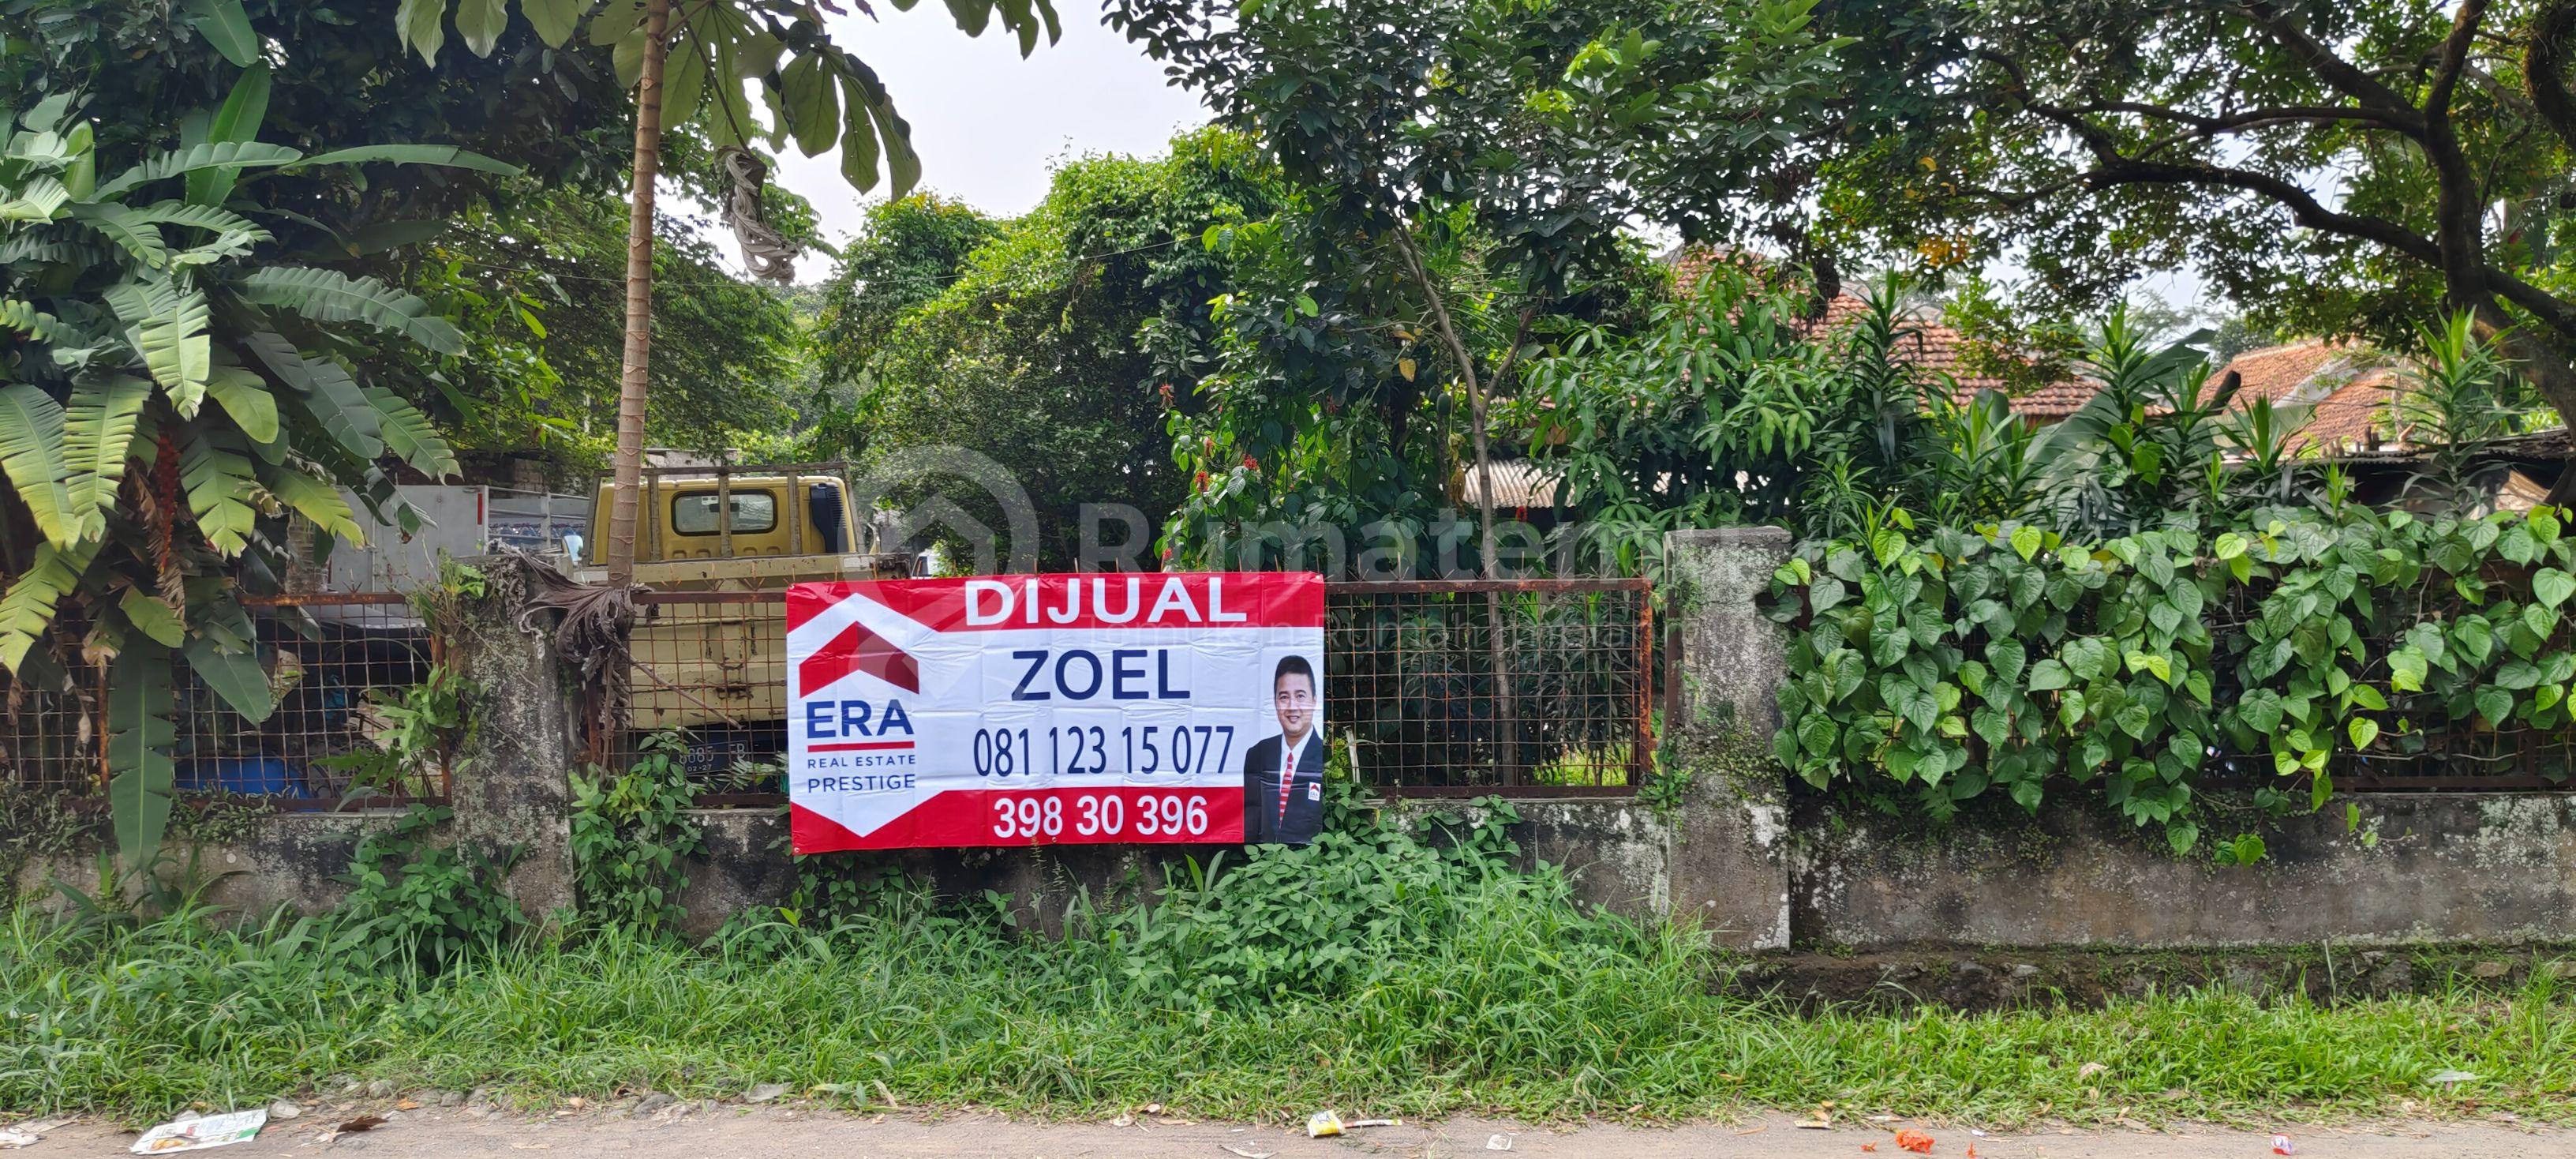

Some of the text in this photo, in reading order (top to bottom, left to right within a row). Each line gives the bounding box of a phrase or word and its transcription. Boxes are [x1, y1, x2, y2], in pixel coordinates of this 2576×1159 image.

[964, 577, 1247, 625] DIJUAL
[1011, 649, 1190, 701] ZOEL
[807, 699, 915, 739] ERA
[807, 755, 916, 769] REAL ESTATE
[973, 726, 1234, 777] 081 123 15 077
[808, 774, 916, 793] PRESTIGE
[993, 795, 1208, 838] 398 30 396
